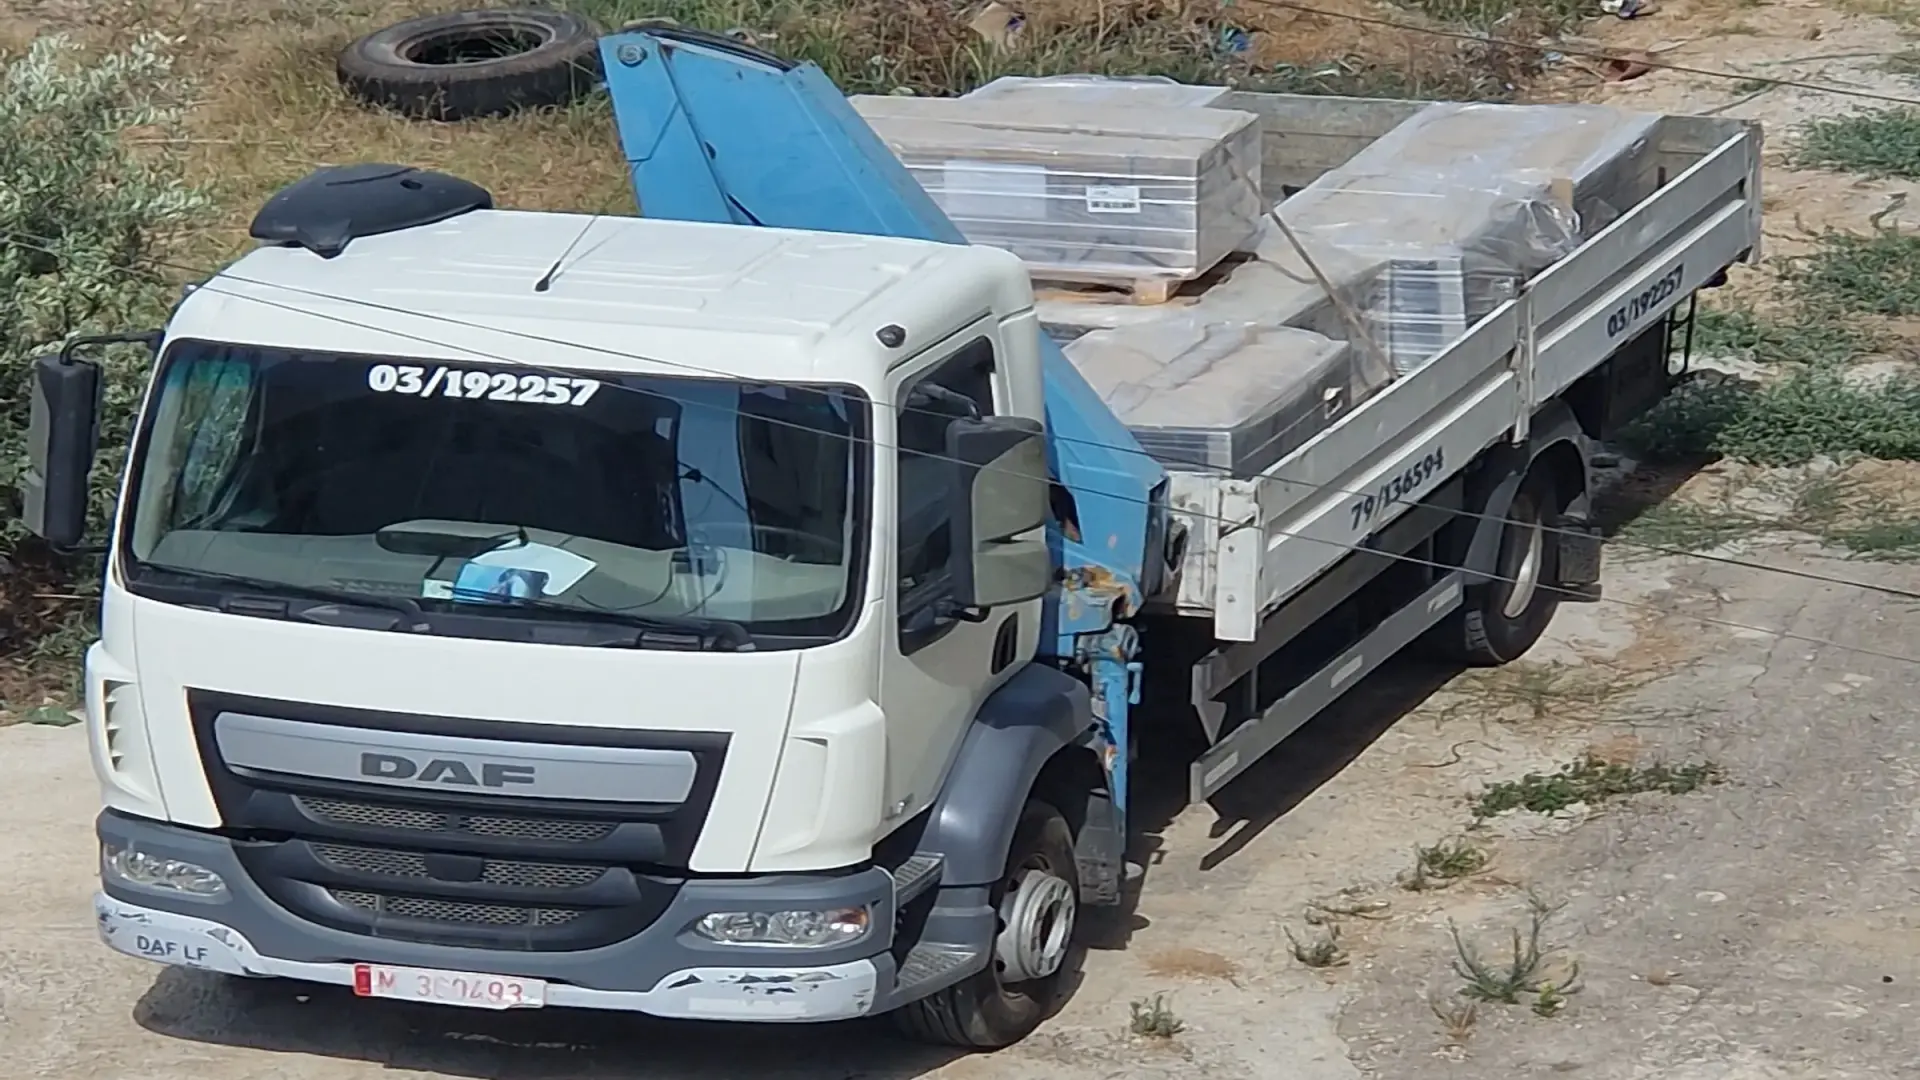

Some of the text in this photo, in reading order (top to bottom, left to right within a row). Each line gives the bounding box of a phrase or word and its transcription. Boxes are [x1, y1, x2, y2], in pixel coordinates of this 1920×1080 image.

[1607, 263, 1684, 338] 03/192257
[368, 364, 600, 406] 03/192257
[1351, 446, 1444, 531] 79/136594
[361, 752, 535, 788] DAF
[137, 935, 208, 961] DAF LF
